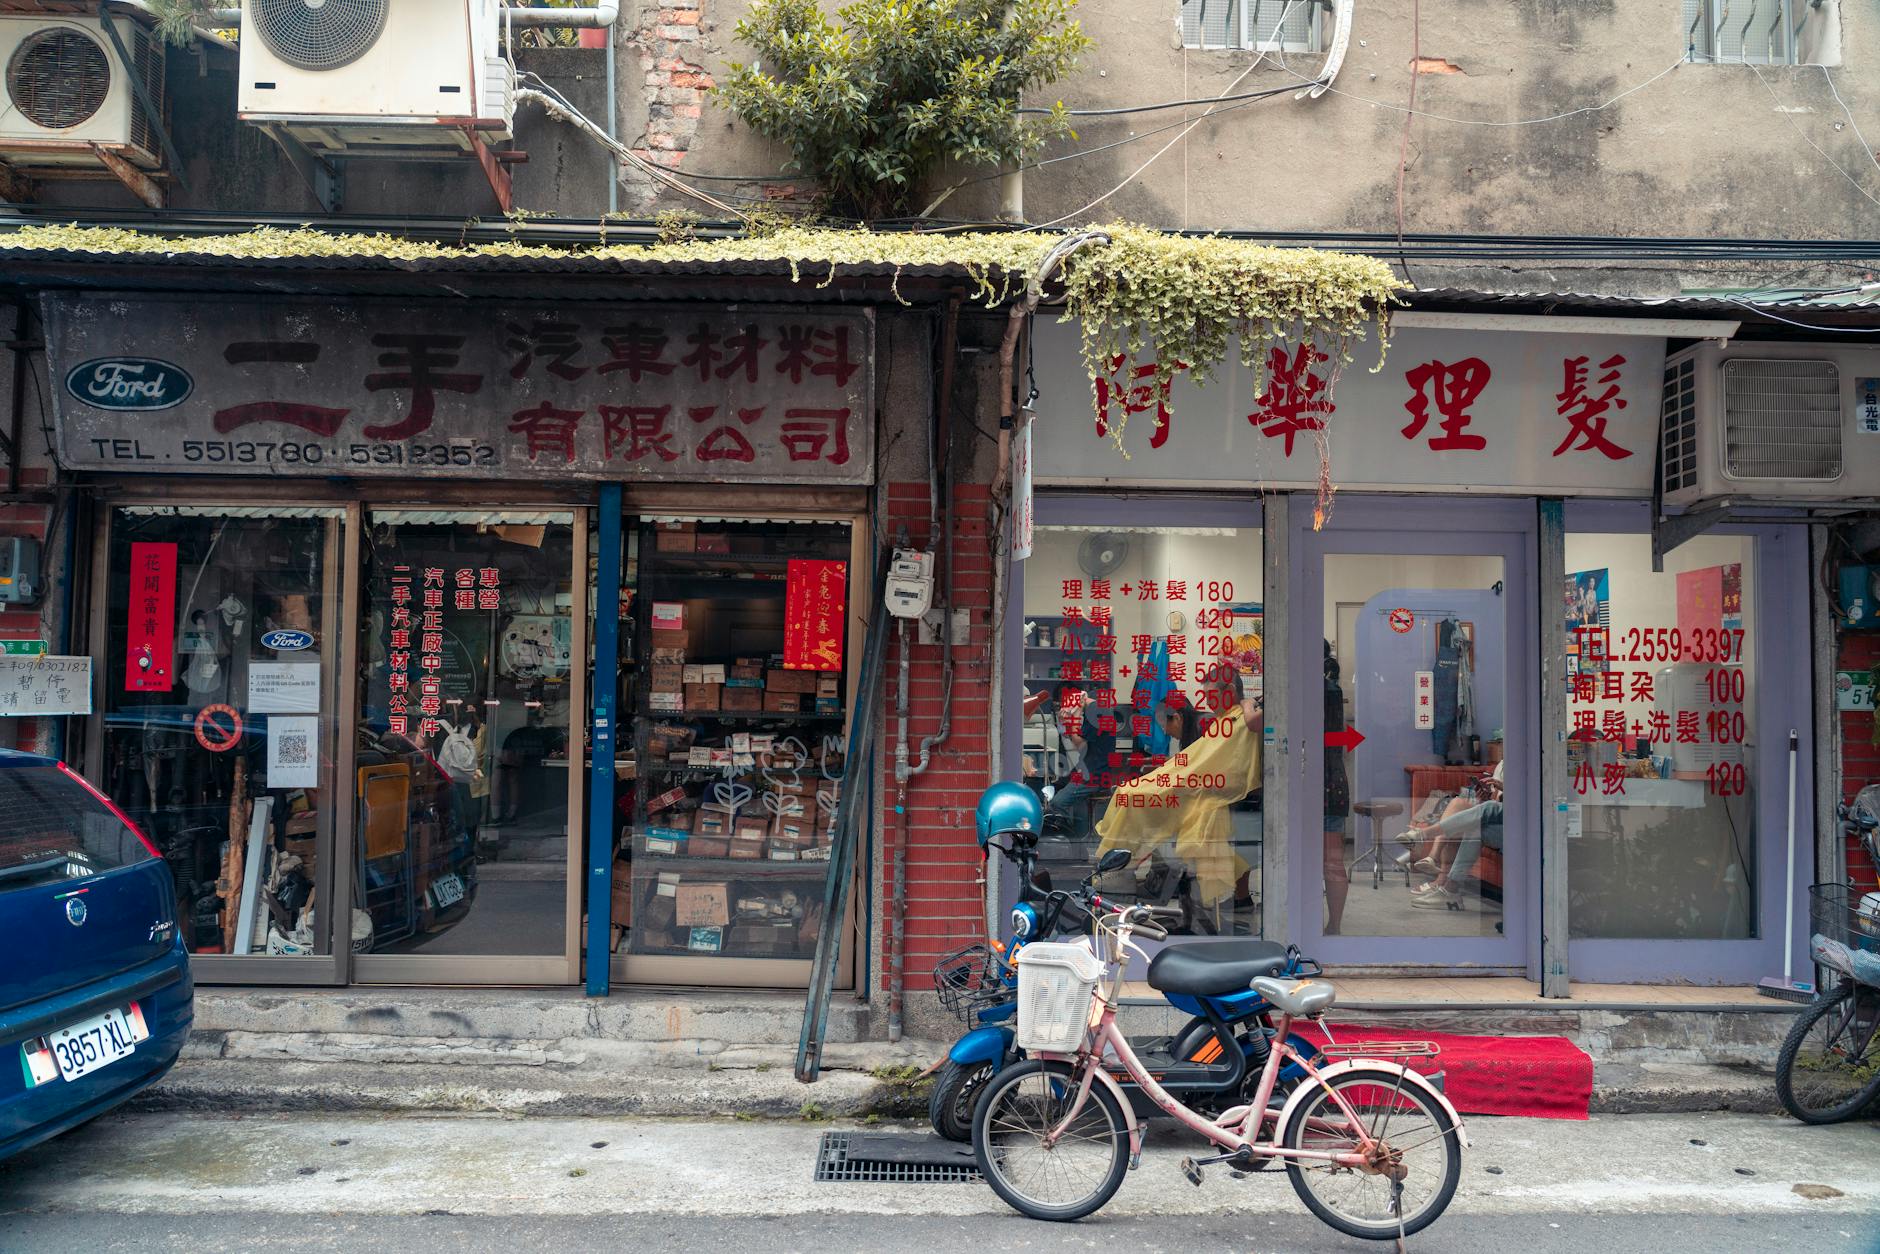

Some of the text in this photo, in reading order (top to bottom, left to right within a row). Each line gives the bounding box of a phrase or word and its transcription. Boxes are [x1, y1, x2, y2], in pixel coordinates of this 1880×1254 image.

[505, 320, 861, 388] 汽車材料
[87, 363, 167, 399] Ford
[213, 333, 484, 441] 二手
[508, 401, 851, 465] 有限公司
[455, 568, 475, 610] 各種
[479, 567, 500, 610] 專營
[1196, 581, 1234, 602] 180
[1062, 606, 1234, 629] 洗髮 120
[388, 565, 412, 737] 二手汽車材料公司
[419, 567, 444, 738] 汽車正廠中古零件
[1062, 634, 1234, 656] 小孩理髮 120
[1195, 662, 1234, 683] 500
[1572, 668, 1745, 704] 掏耳朵 100
[1194, 689, 1234, 711] 250
[1852, 689, 1872, 704] 51
[1200, 717, 1234, 738] 100
[1707, 711, 1745, 744] 180
[1573, 762, 1745, 796] 小孩 120
[1115, 795, 1180, 808] 周日公休
